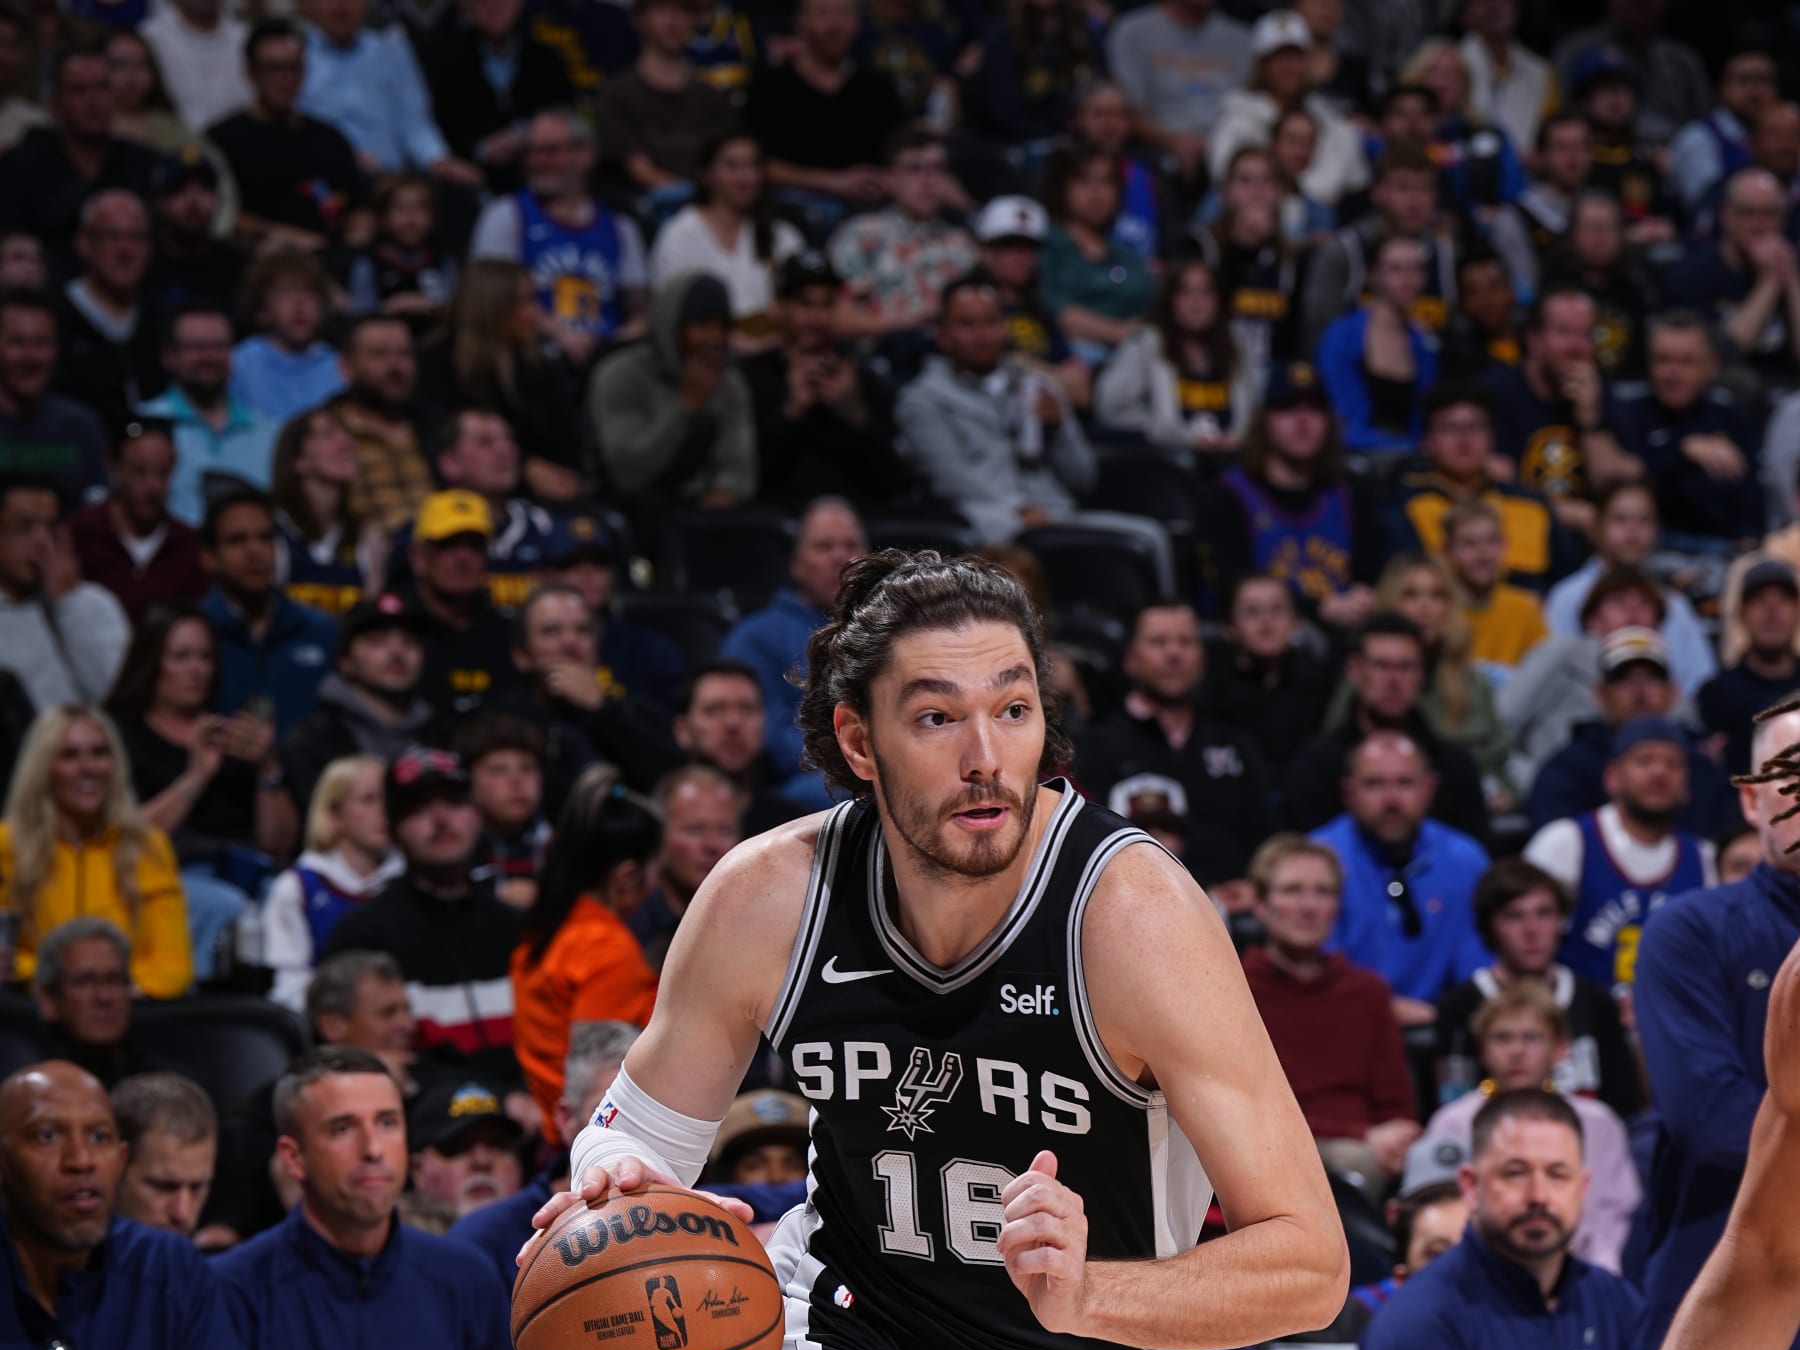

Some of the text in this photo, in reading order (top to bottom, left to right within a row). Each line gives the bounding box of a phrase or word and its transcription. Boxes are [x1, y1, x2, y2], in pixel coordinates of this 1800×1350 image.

[1000, 983, 1060, 1016] Self.
[871, 1149, 1018, 1265] 16
[553, 1204, 740, 1267] Wilson
[583, 1310, 645, 1333] OFFICIAL GAME BALL
